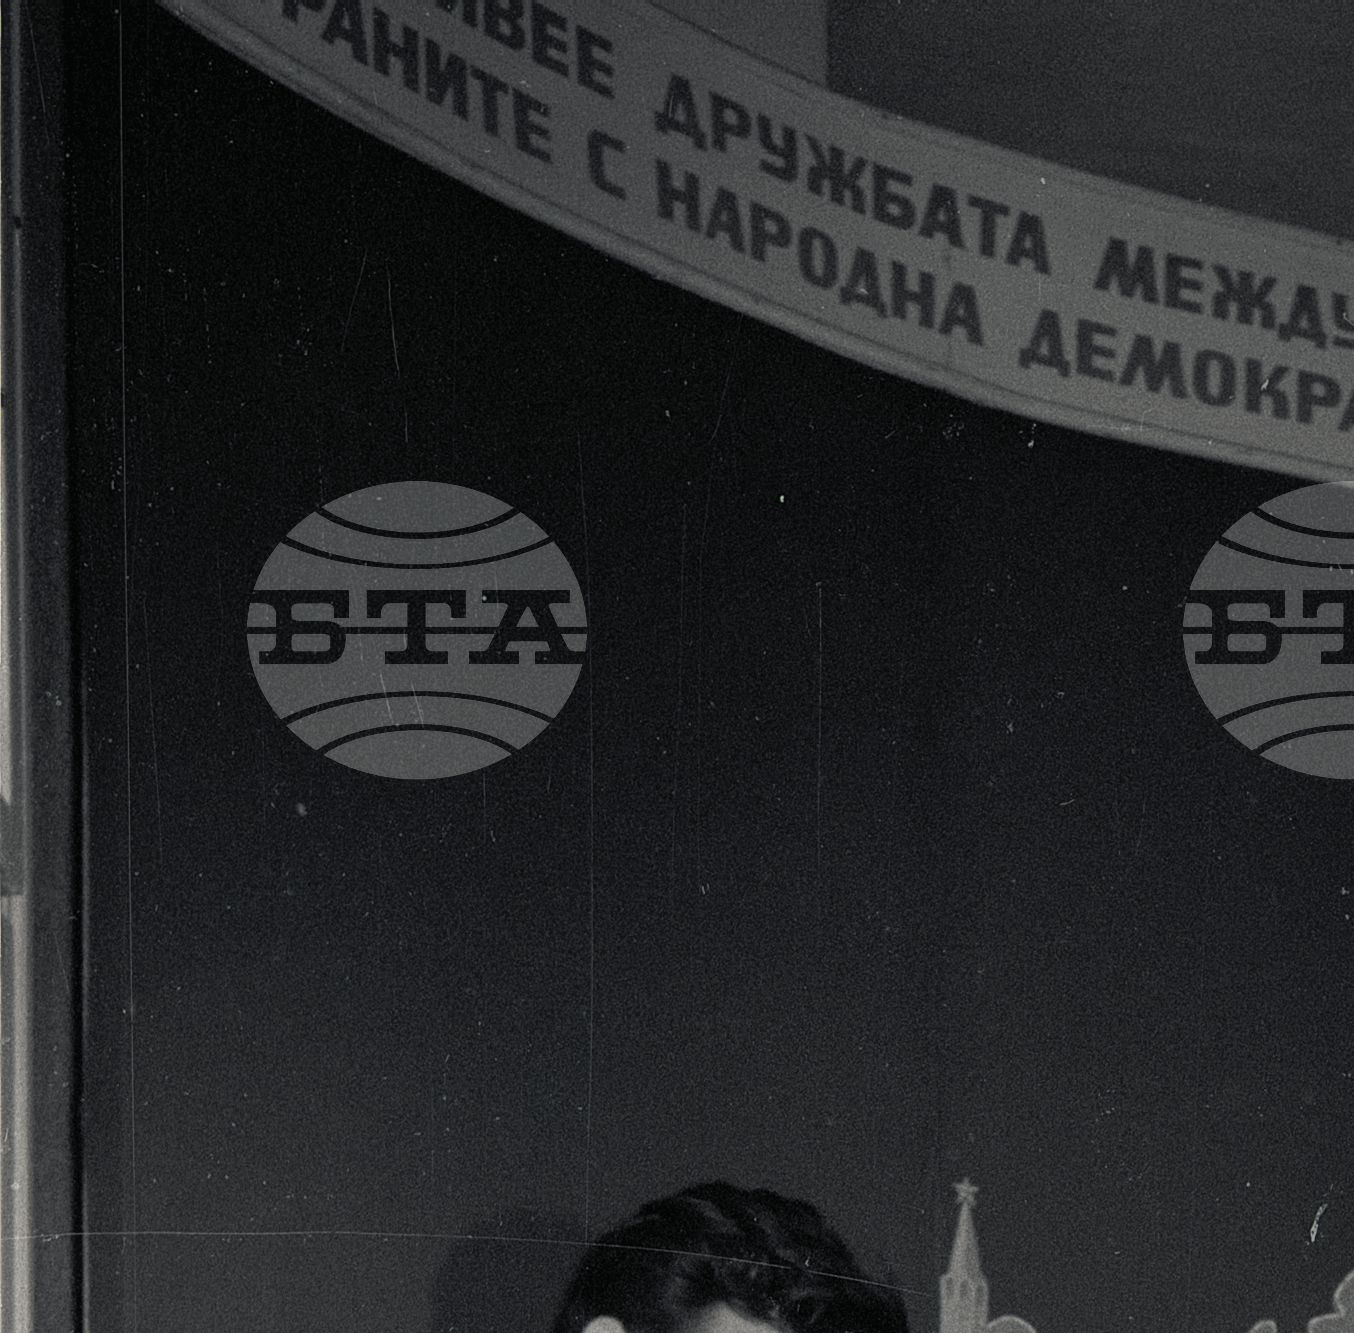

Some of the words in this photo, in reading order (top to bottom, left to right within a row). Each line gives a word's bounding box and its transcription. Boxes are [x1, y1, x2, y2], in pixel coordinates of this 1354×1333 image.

[587, 128, 627, 201] С
[655, 156, 984, 347] НАРОДНА
[654, 74, 1051, 275] ДРУЖБАТА
